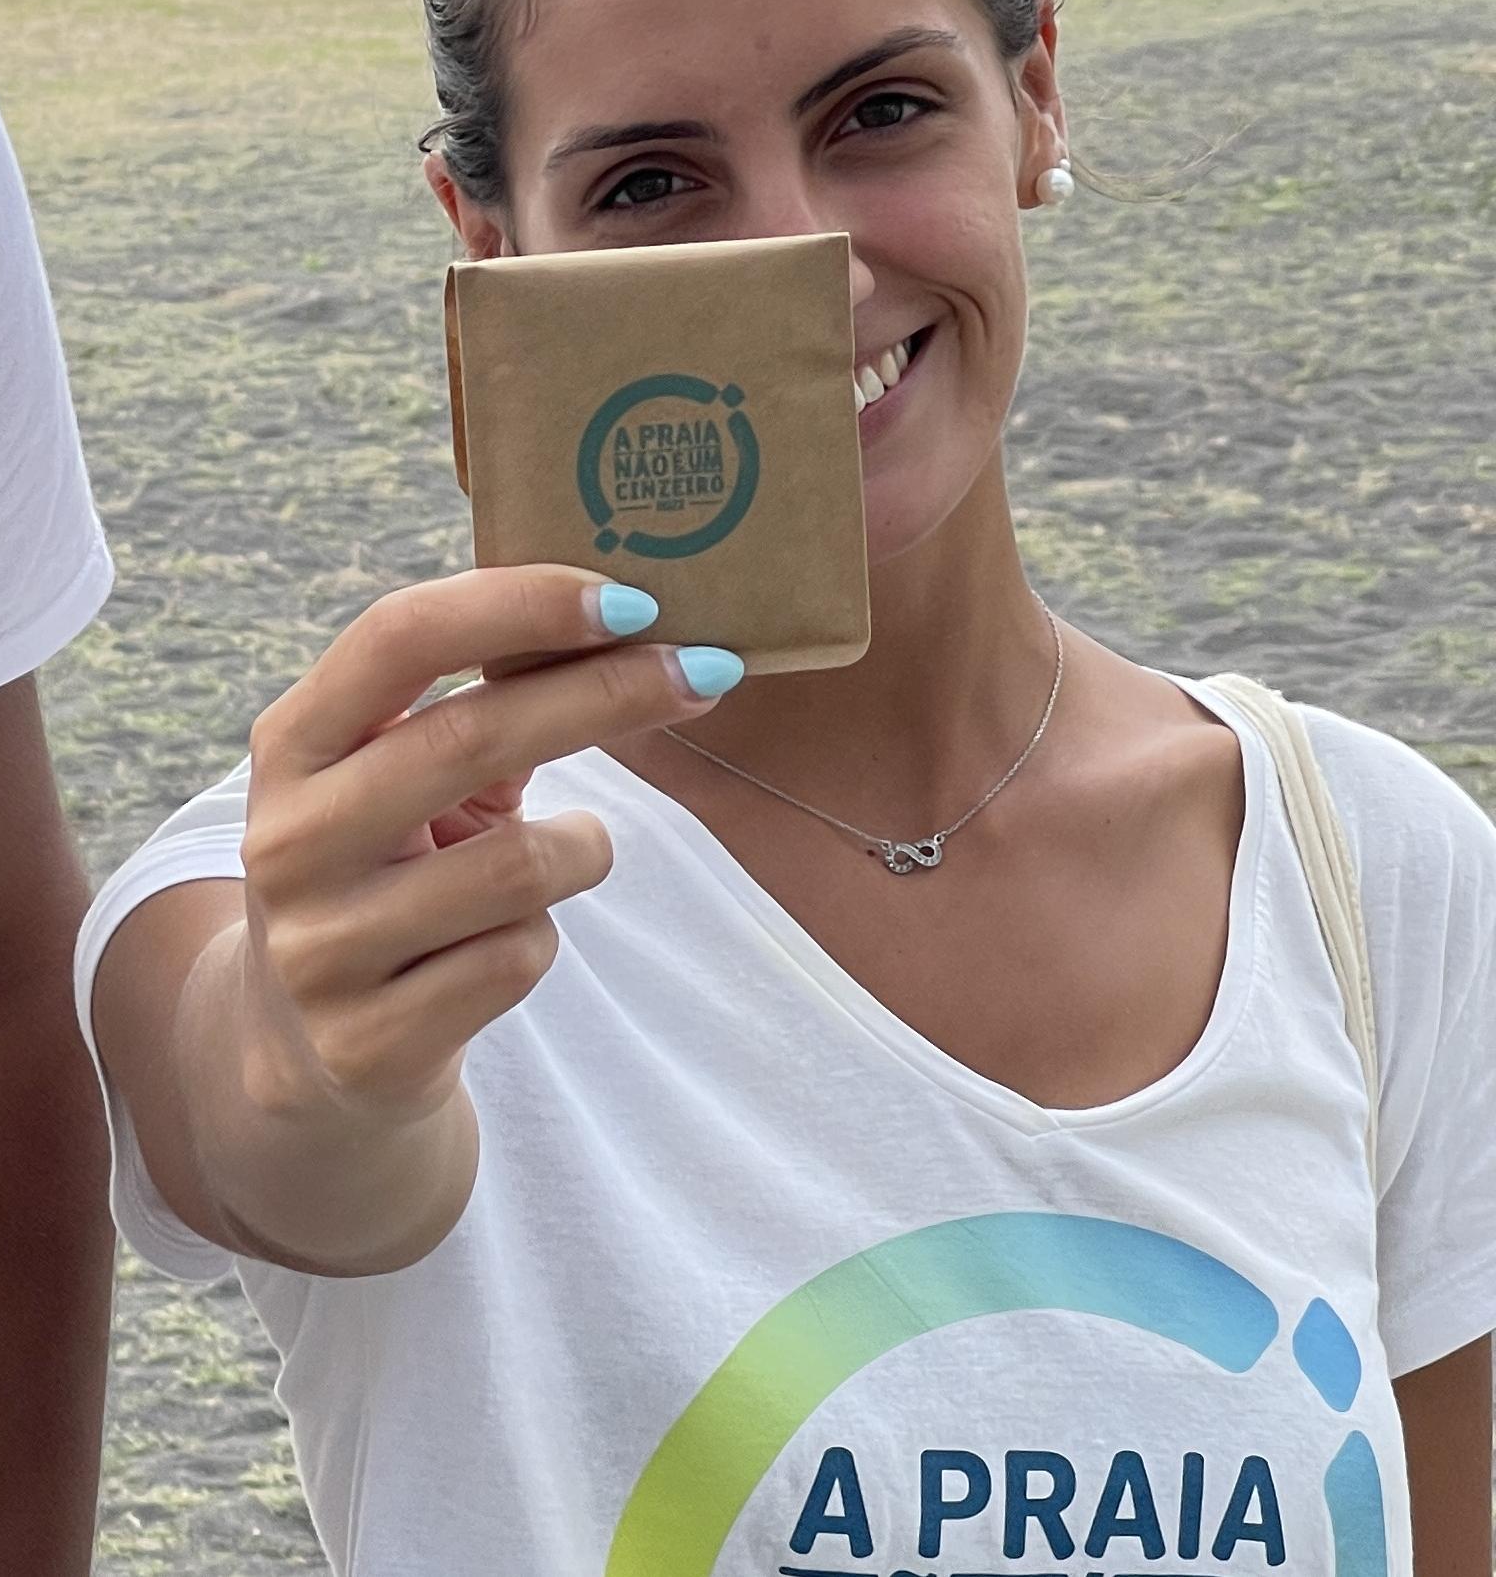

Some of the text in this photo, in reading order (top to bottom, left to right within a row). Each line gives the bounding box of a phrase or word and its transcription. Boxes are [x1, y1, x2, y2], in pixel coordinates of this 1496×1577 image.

[615, 419, 721, 452] A PRAIA
[615, 475, 724, 501] CINZEIRO
[789, 1446, 1286, 1566] A PRAIA
